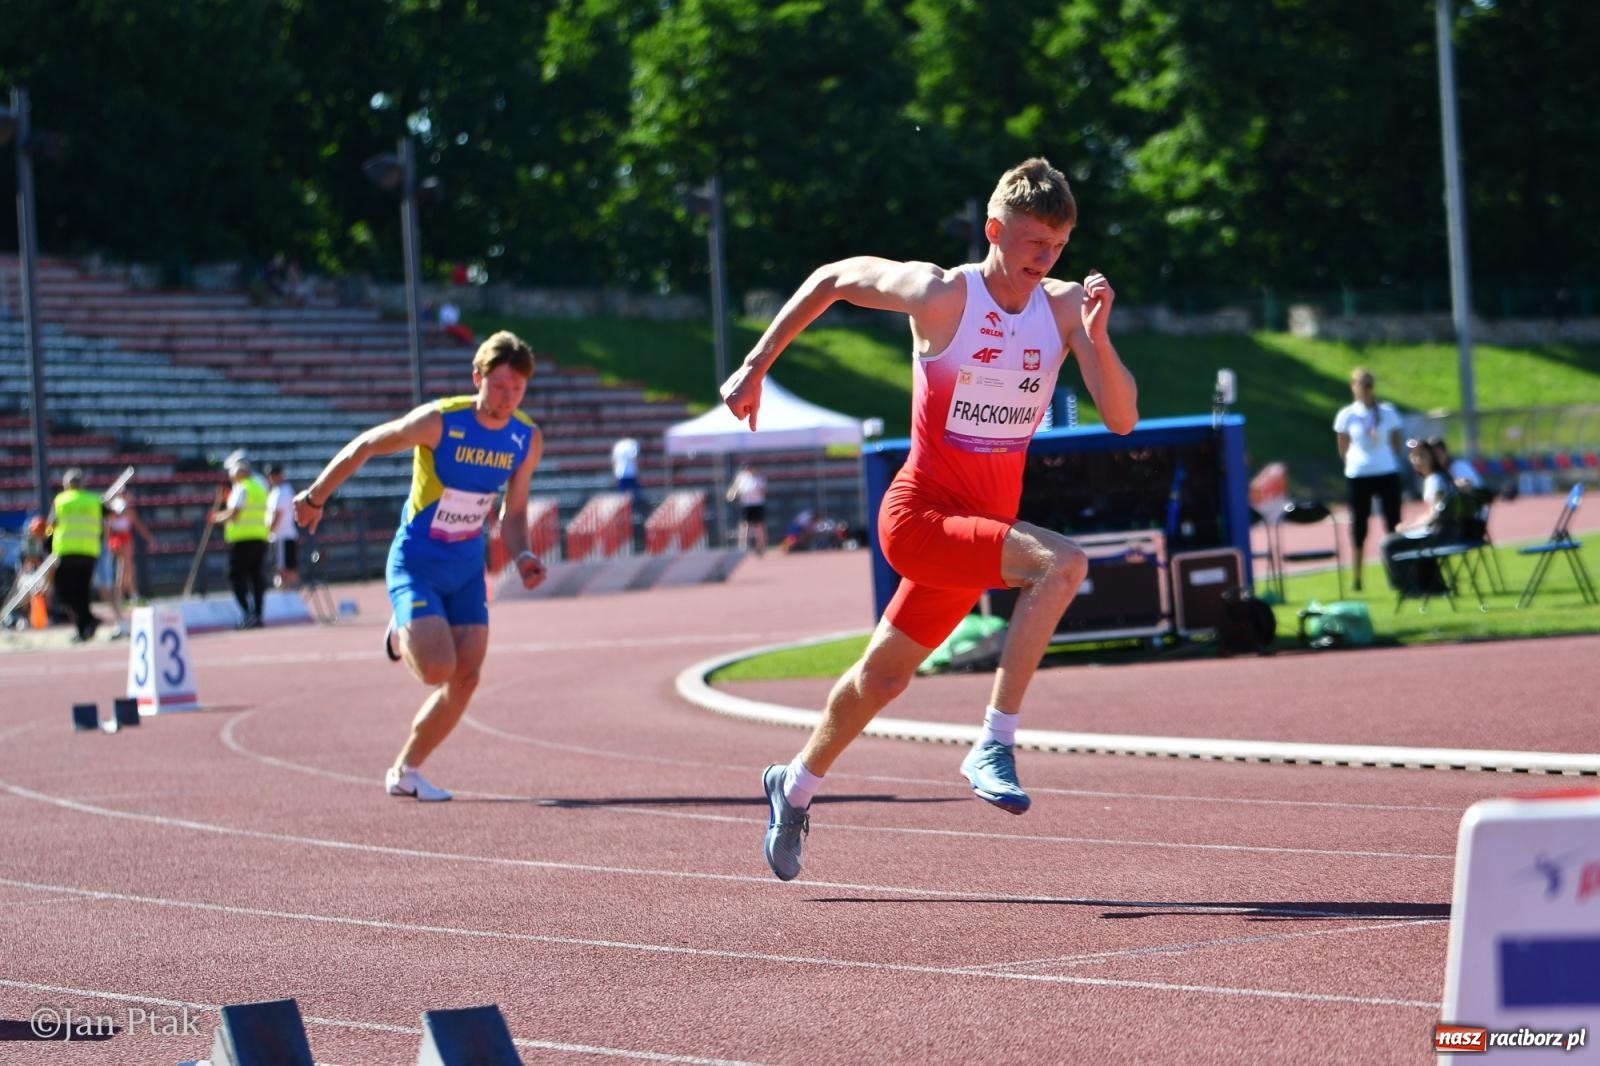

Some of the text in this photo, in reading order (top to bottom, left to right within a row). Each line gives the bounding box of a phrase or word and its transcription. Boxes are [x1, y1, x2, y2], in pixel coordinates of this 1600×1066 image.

[980, 327, 1004, 338] ORLEN
[972, 347, 1003, 364] 4F
[1018, 377, 1040, 393] 46
[455, 446, 515, 470] UKRAINE
[135, 631, 148, 687] 3
[161, 629, 185, 686] 3
